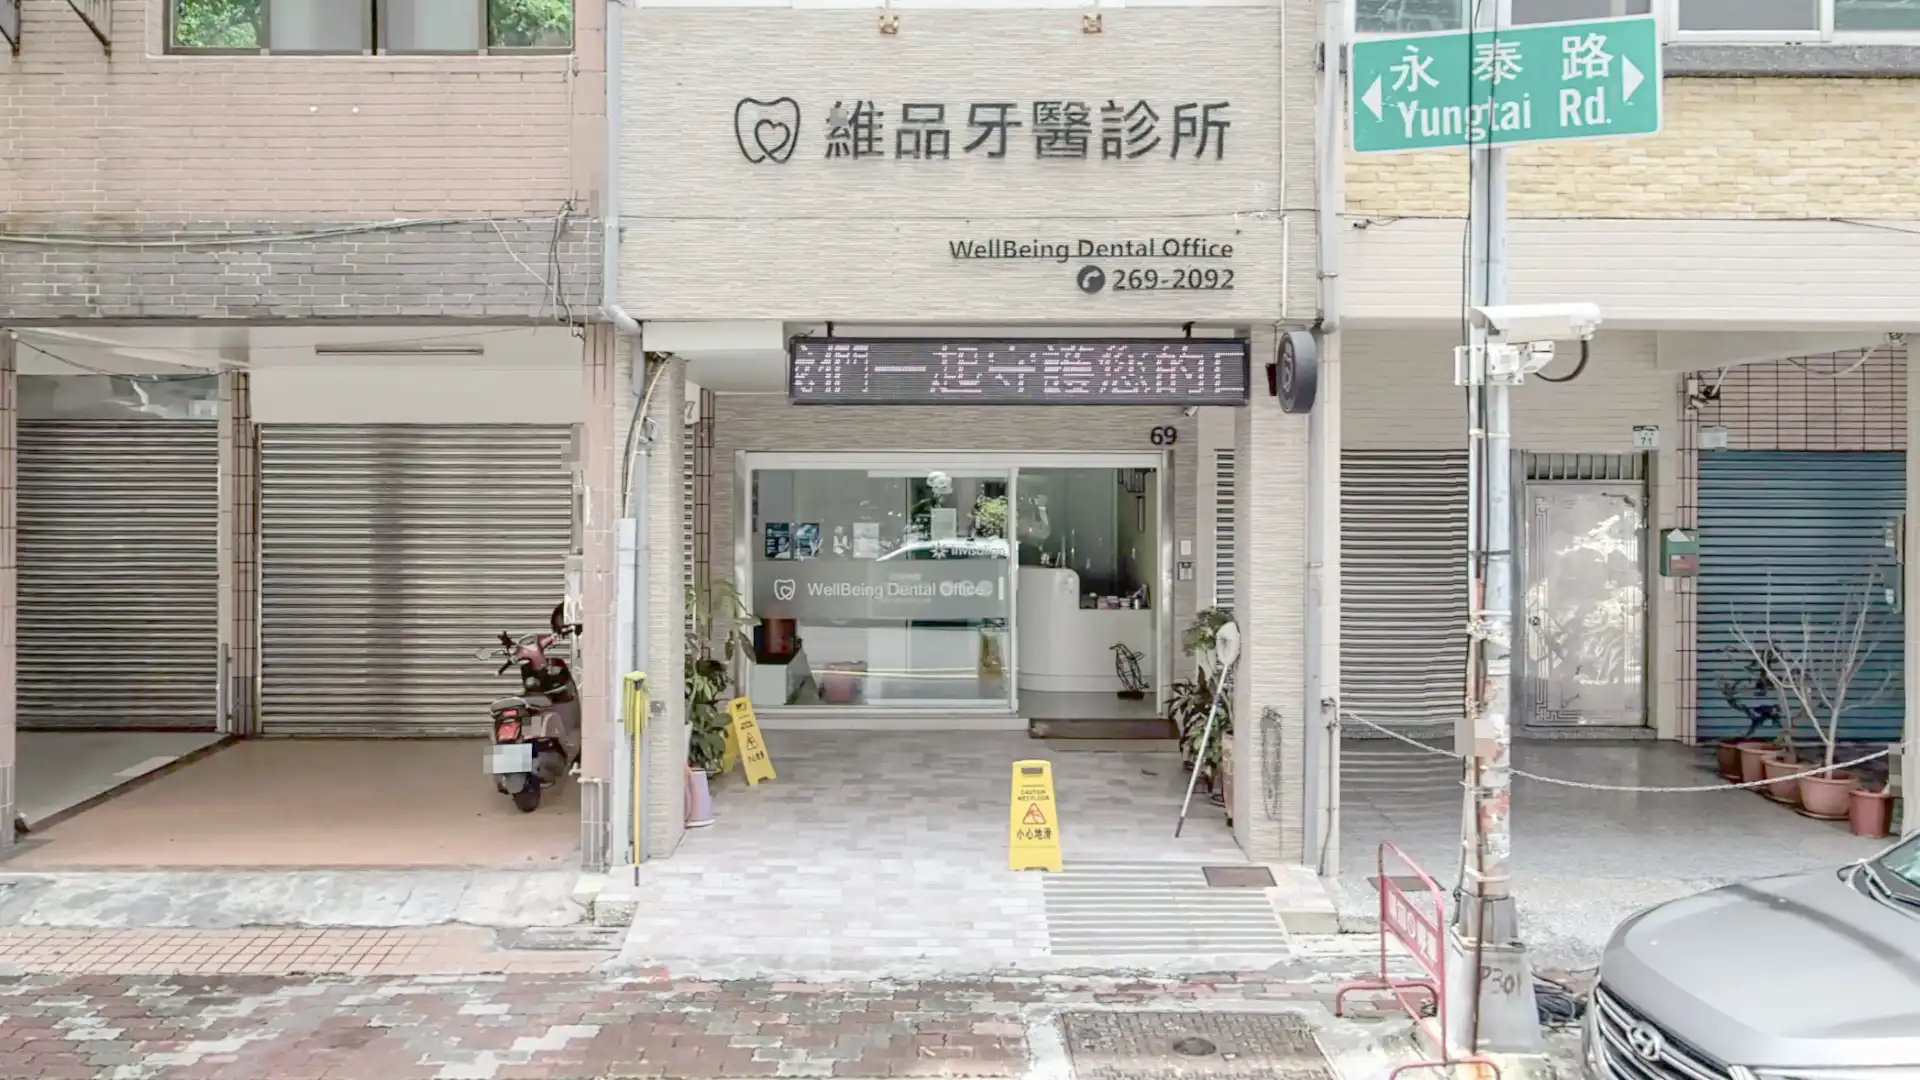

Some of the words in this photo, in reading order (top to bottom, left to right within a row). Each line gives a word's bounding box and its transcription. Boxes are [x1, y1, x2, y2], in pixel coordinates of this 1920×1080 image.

[1389, 32, 1615, 93] 永泰路
[1397, 92, 1532, 142] Yungtai
[1560, 86, 1613, 128] Rd.
[824, 98, 1232, 162] 維品牙醫診所
[949, 239, 1071, 264] WellBeing
[1078, 238, 1155, 258] Dental
[1163, 238, 1235, 259] Office
[1112, 267, 1236, 292] 269-2092
[1151, 426, 1178, 446] 69
[807, 581, 884, 600] WellBeing
[887, 581, 937, 597] Dental
[939, 580, 985, 597] Office
